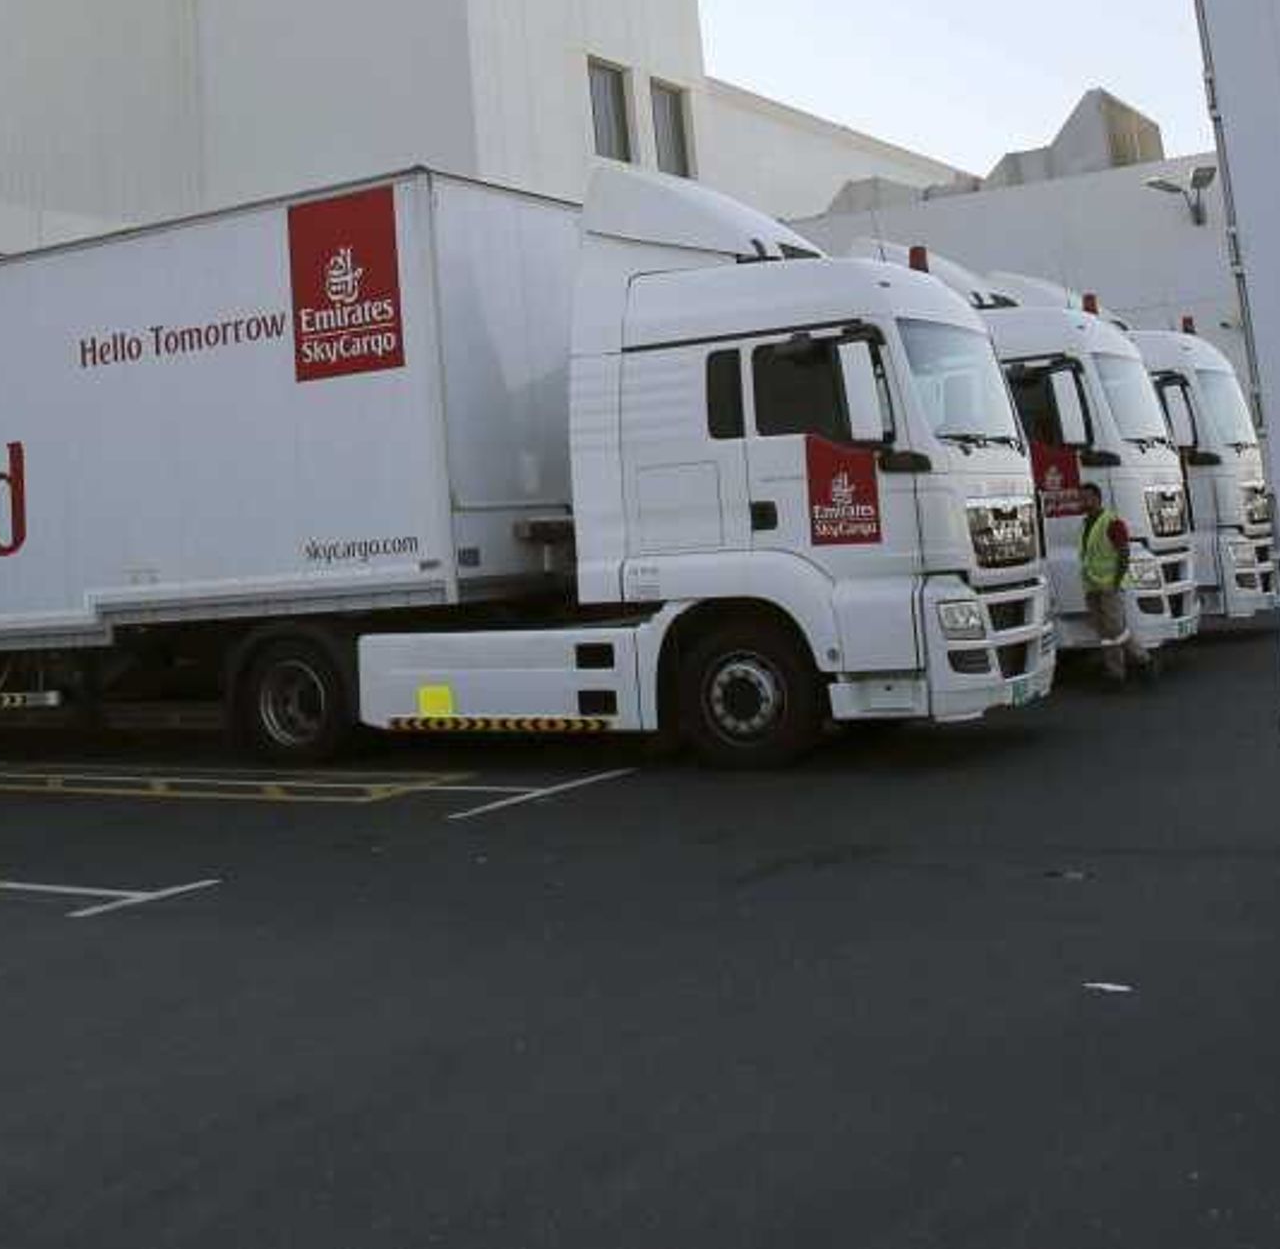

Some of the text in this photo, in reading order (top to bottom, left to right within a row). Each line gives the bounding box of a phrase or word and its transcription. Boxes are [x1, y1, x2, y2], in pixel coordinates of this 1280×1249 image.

[300, 298, 395, 332] Emirates
[79, 311, 287, 368] Hello Tomorrow
[302, 331, 397, 364] SkyCargo
[306, 536, 418, 563] skycargo.com
